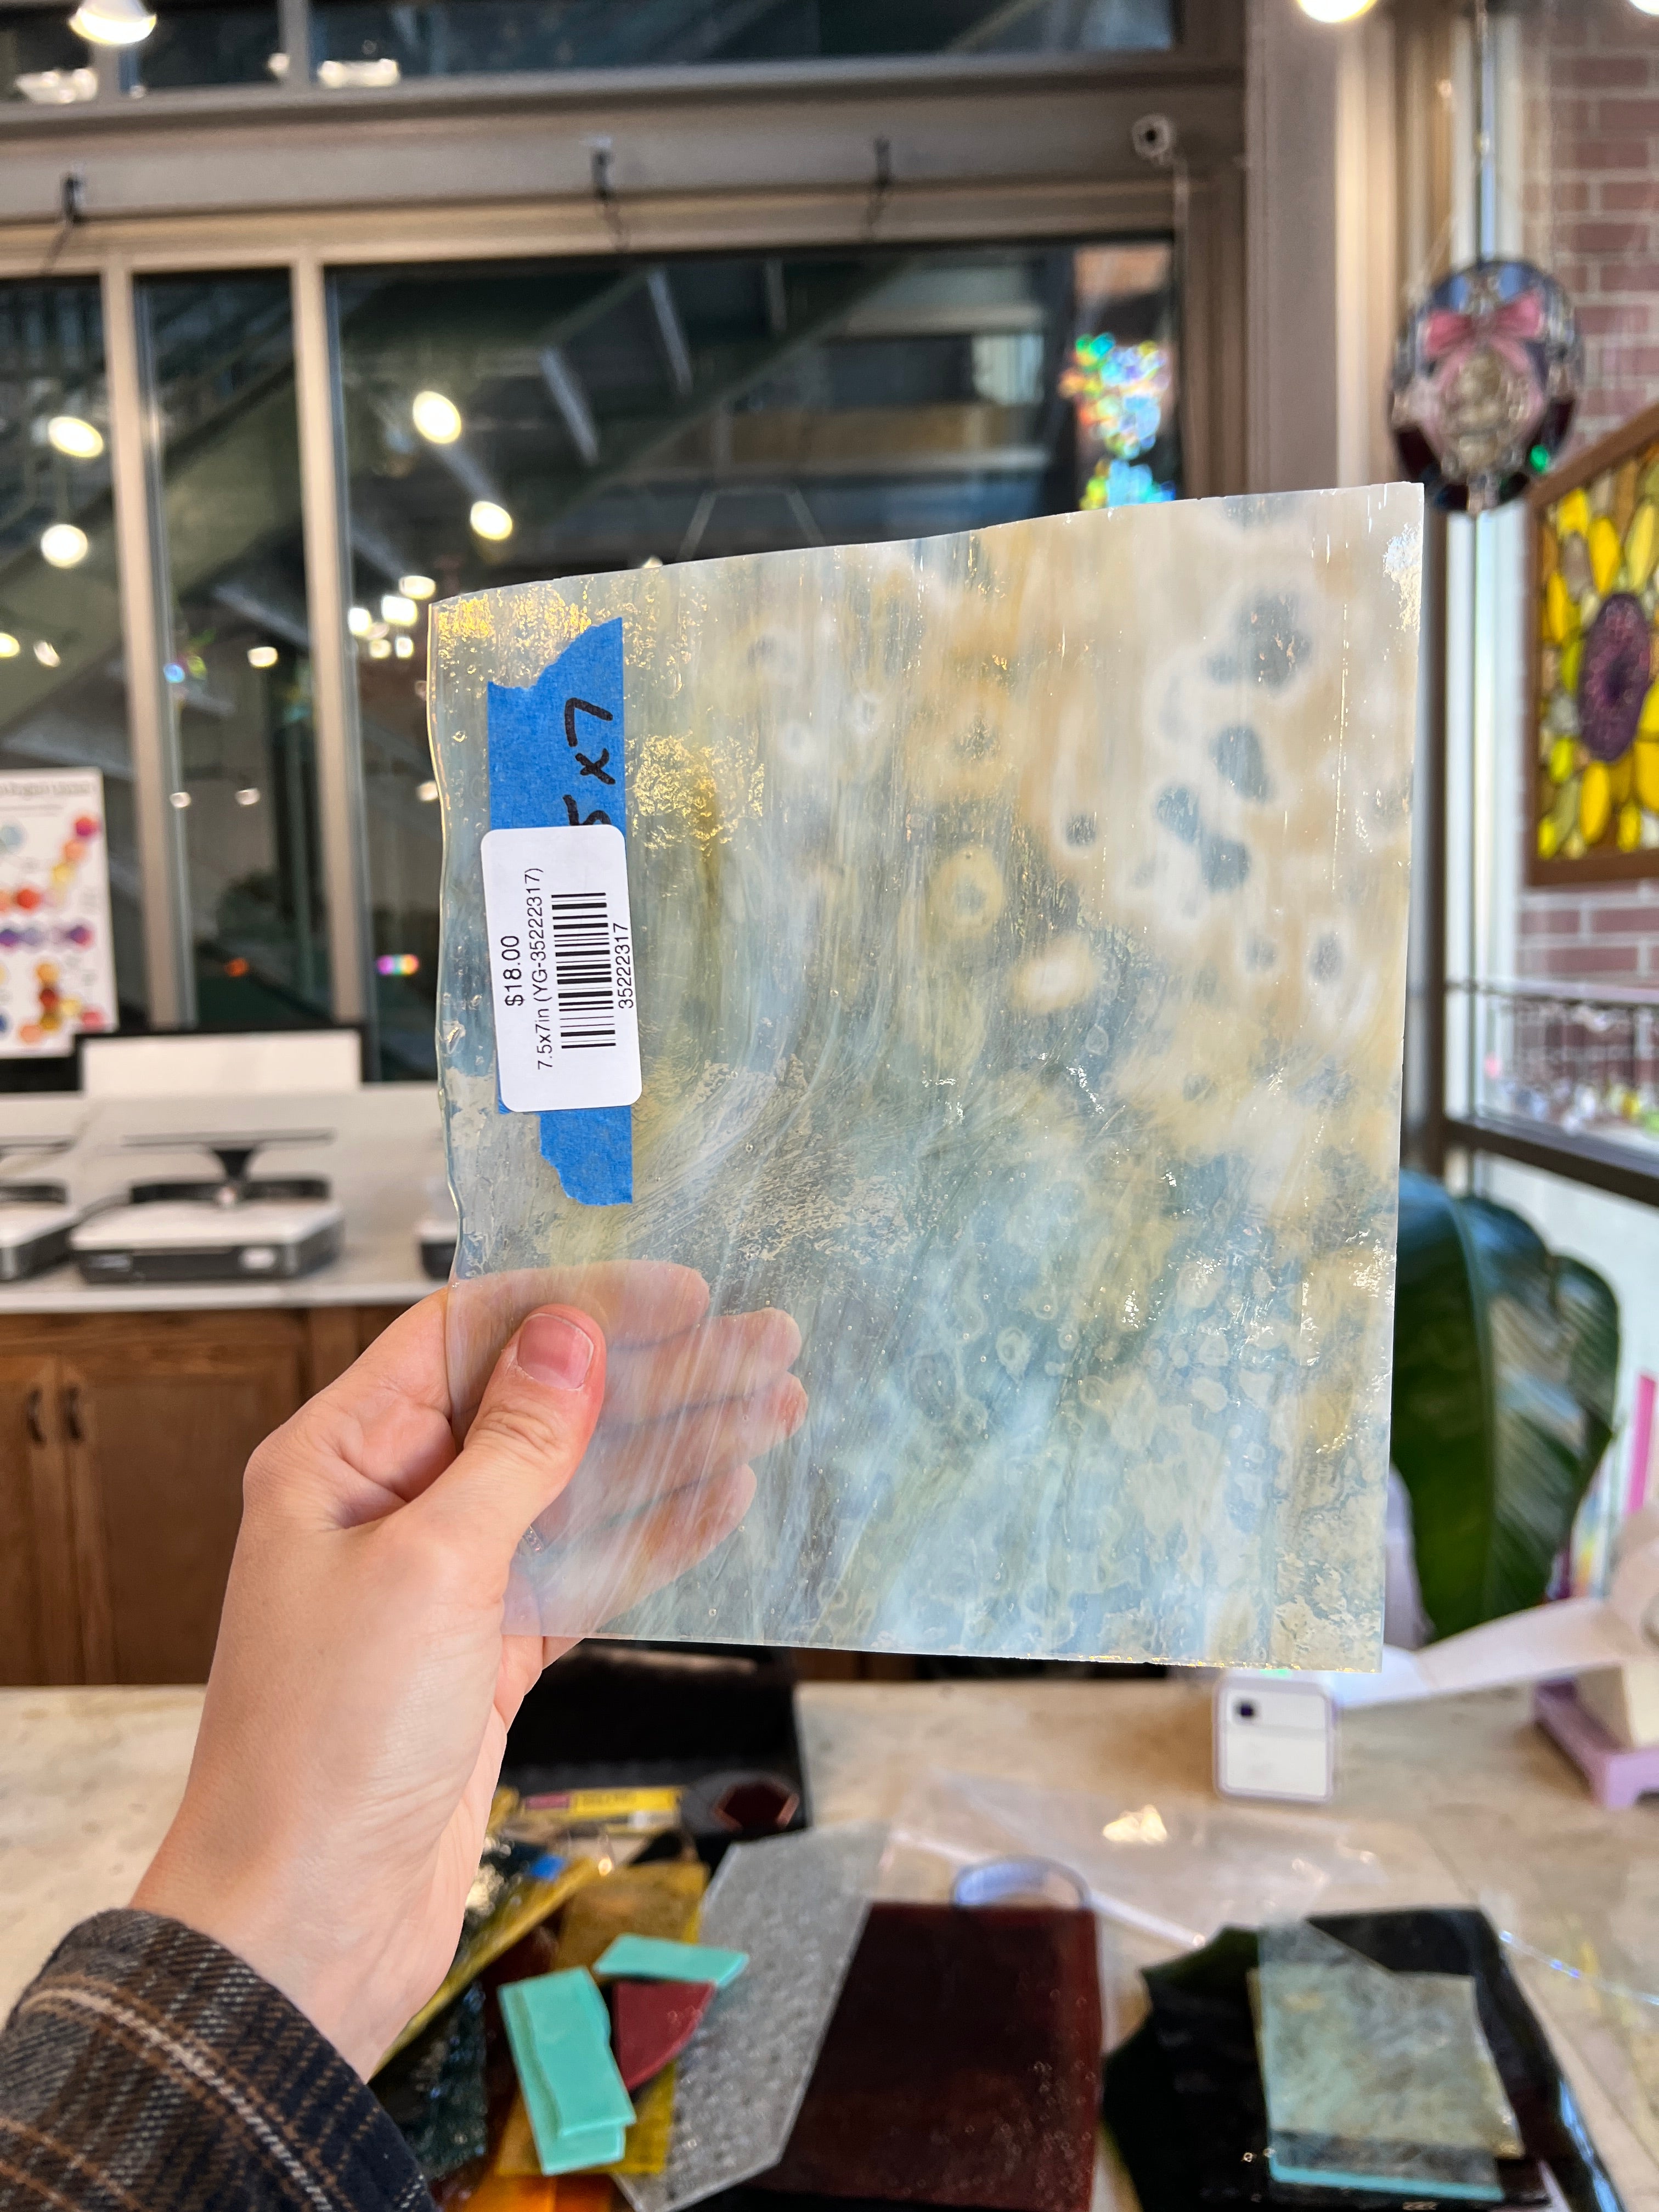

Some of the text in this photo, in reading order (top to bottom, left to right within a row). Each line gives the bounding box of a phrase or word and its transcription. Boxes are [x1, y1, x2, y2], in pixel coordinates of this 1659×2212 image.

[500, 936, 525, 1006] $18.00
[524, 868, 553, 1070] 7.5x7in (YG-35222317)
[613, 923, 634, 1008] 35222317
